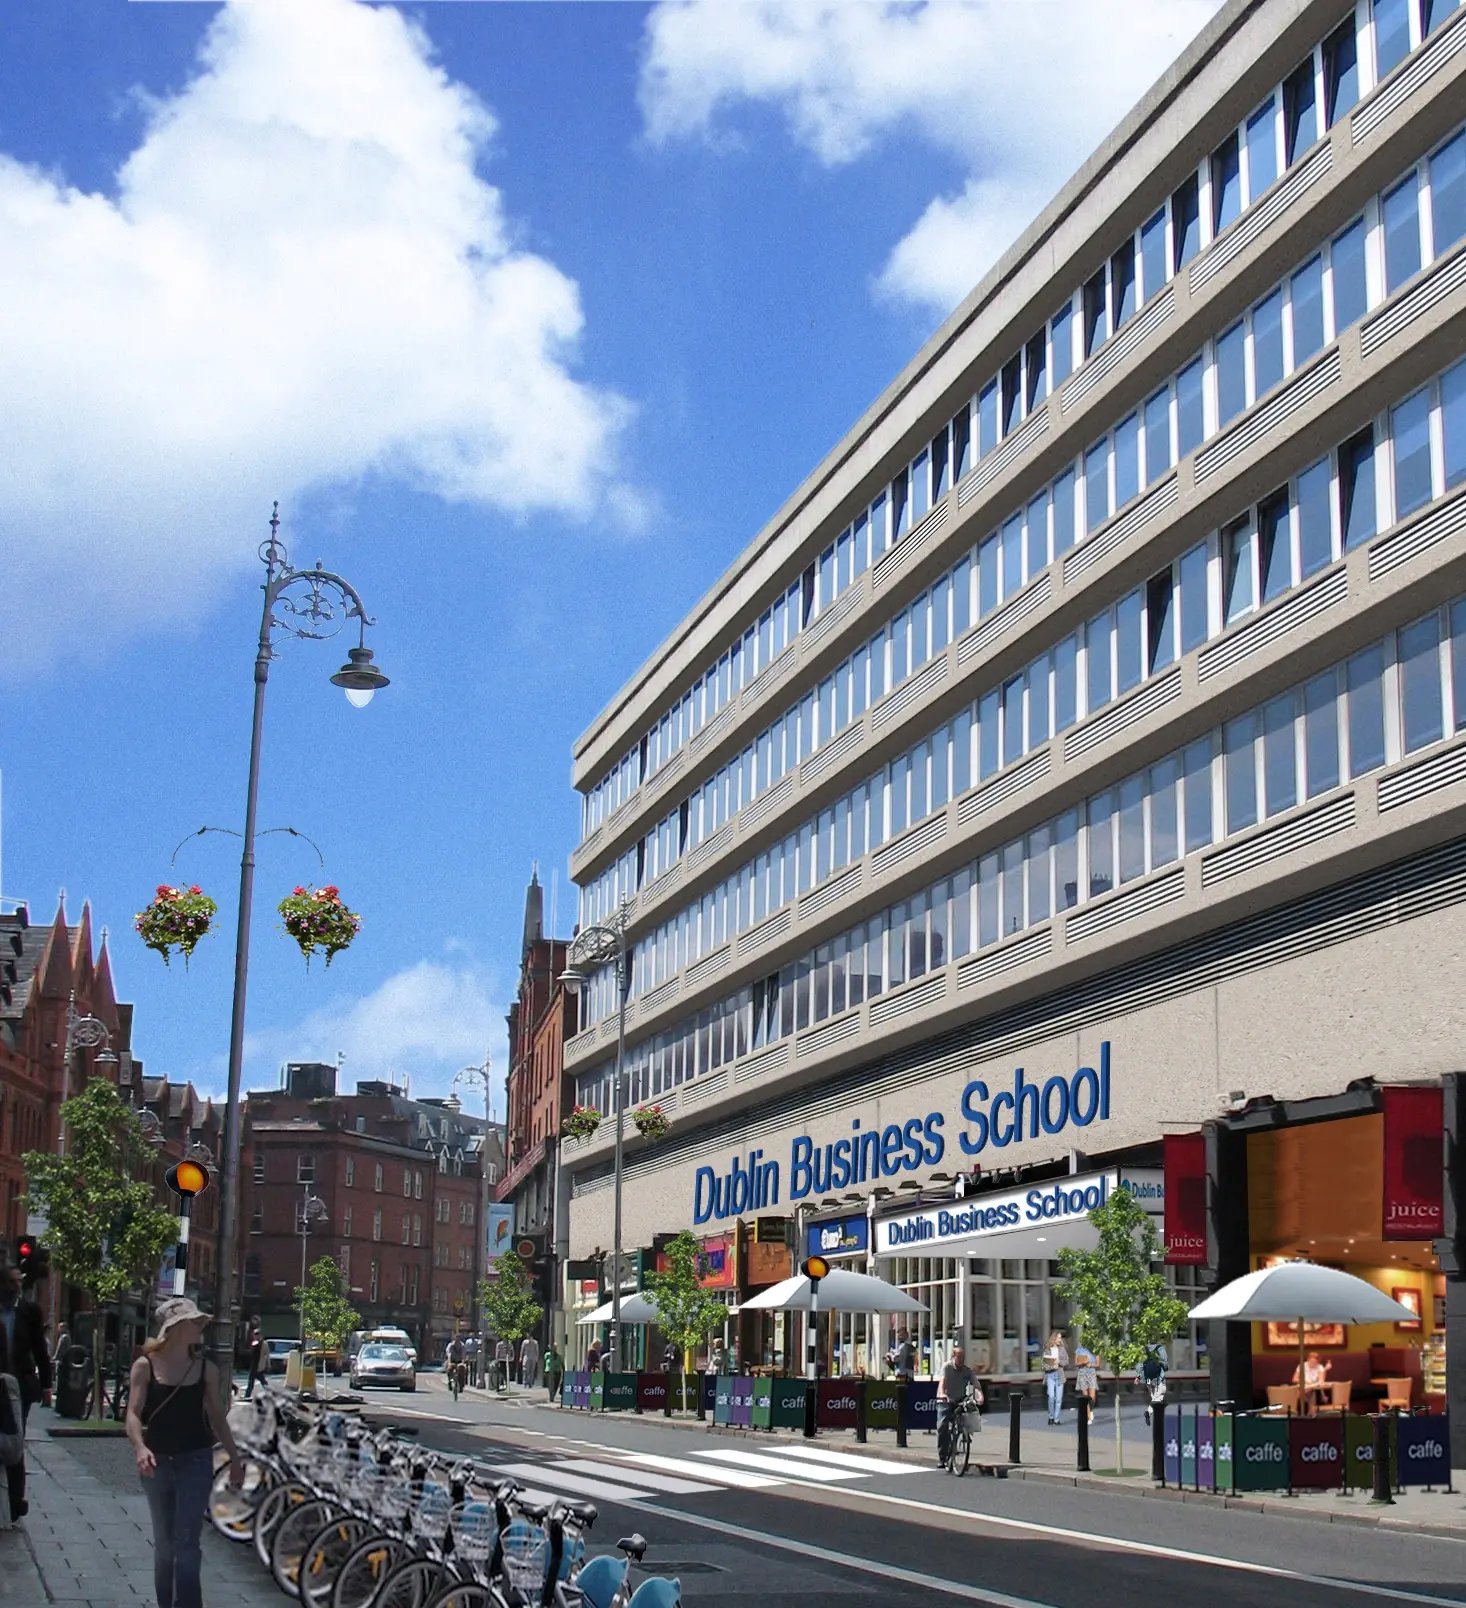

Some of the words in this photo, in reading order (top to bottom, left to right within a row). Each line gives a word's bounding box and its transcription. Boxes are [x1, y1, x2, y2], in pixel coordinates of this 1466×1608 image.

[693, 1148, 779, 1225] Dublin
[790, 1119, 945, 1200] Business
[959, 1041, 1111, 1155] School
[1132, 1182, 1155, 1198] Dublin
[888, 1215, 932, 1246] Dublin
[938, 1205, 1020, 1238] Business
[1026, 1175, 1107, 1221] School
[1387, 1201, 1440, 1220] juice
[1169, 1234, 1204, 1248] juice
[643, 1386, 666, 1396] caffe
[781, 1396, 806, 1409] caff
[826, 1396, 857, 1410] caffe
[914, 1398, 937, 1412] caff
[1246, 1442, 1282, 1462] caffe
[1301, 1441, 1338, 1461] caffe
[1408, 1439, 1443, 1459] caffe
